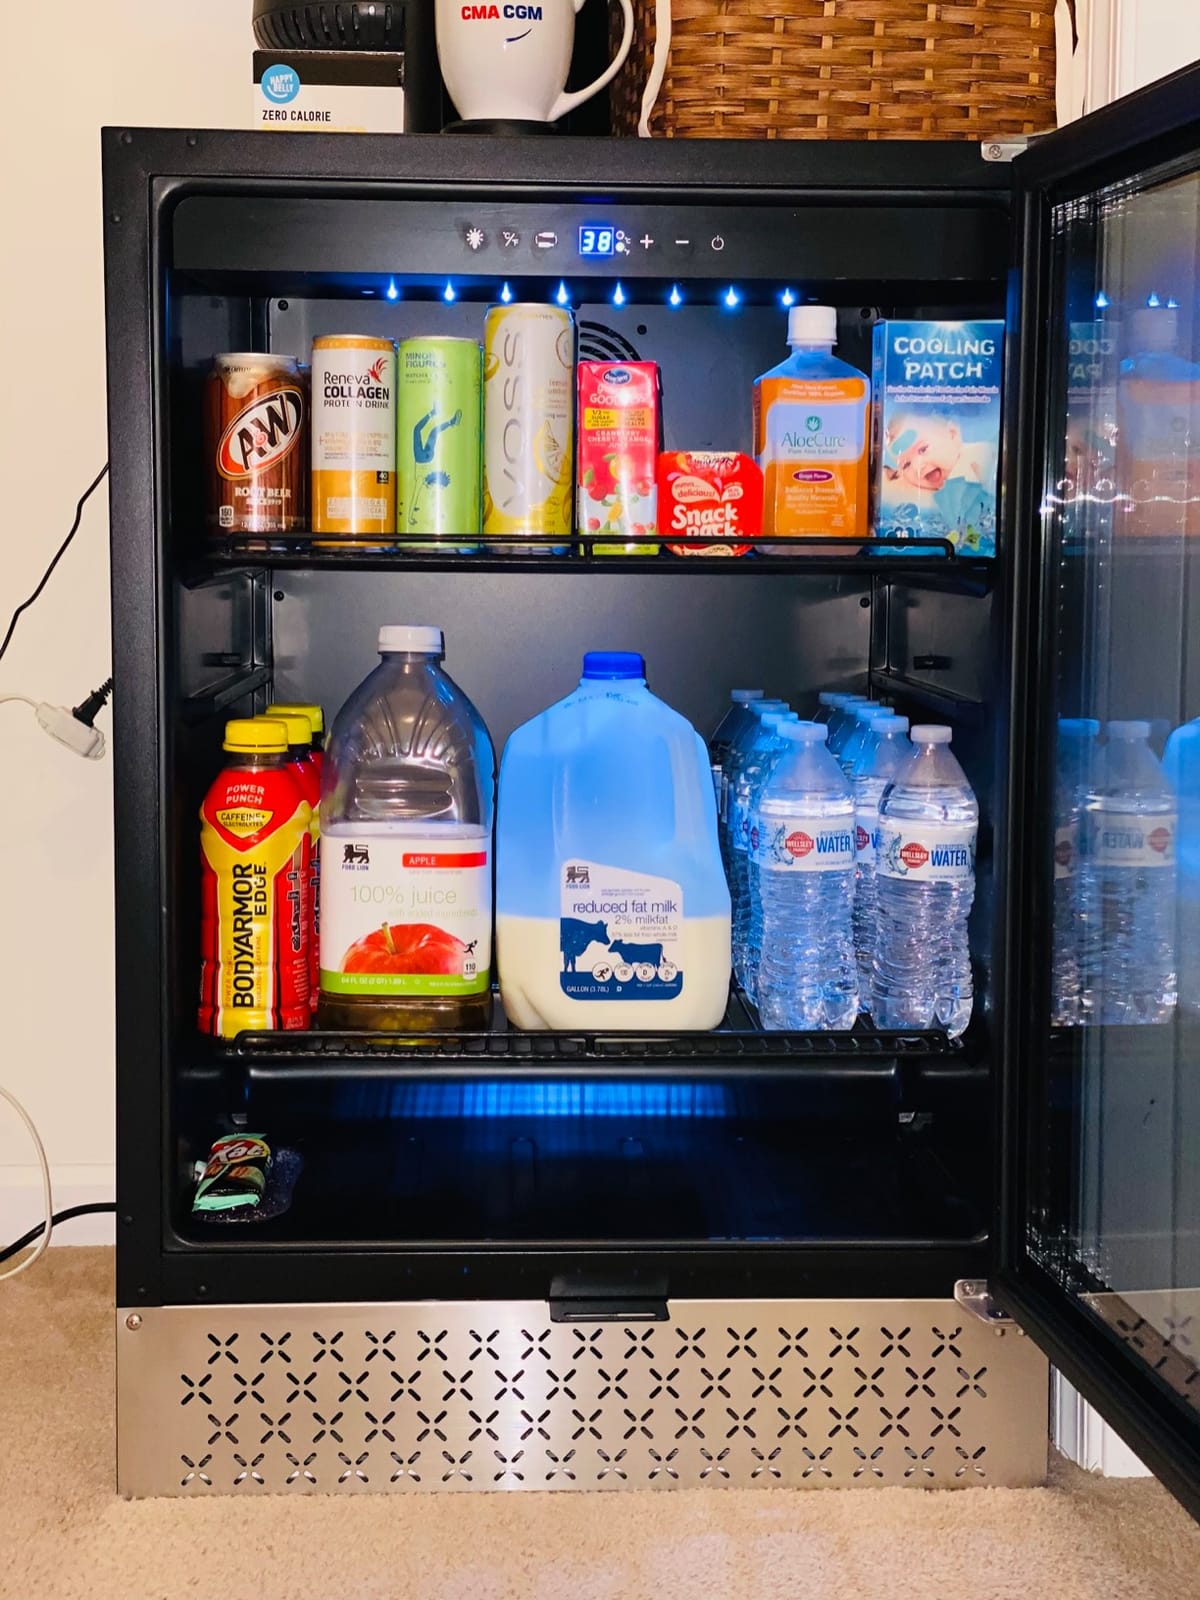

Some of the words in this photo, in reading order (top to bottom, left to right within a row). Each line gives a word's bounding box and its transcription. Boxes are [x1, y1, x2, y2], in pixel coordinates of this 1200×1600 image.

[461, 6, 499, 21] CMA
[503, 5, 542, 20] CGM
[270, 73, 293, 85] HAPPY
[262, 110, 287, 120] ZERO
[291, 111, 331, 121] CALORIE
[582, 230, 612, 252] 38
[894, 337, 995, 356] COOLING
[406, 360, 446, 368] FIGUR
[905, 361, 982, 381] PATCH
[324, 372, 370, 385] Reneva
[324, 386, 389, 400] COLLAGEN
[781, 432, 846, 447] AloeCure
[234, 487, 265, 497] ROT
[267, 488, 292, 498] BEER
[671, 502, 738, 530] Snack
[686, 521, 738, 536] pack
[227, 784, 264, 795] POWER
[226, 794, 263, 805] PUNCH
[816, 835, 850, 853] WATER
[409, 857, 436, 865] APPLE
[931, 849, 966, 866] WATER
[254, 864, 267, 916] EDGE
[351, 885, 404, 904] 100%
[411, 885, 457, 908] juice
[573, 900, 627, 913] reduced
[631, 900, 648, 913] fat
[651, 900, 678, 913] milk
[615, 915, 632, 925] 2%
[635, 914, 669, 925] milkfat
[233, 863, 254, 1009] BODYARMOR
